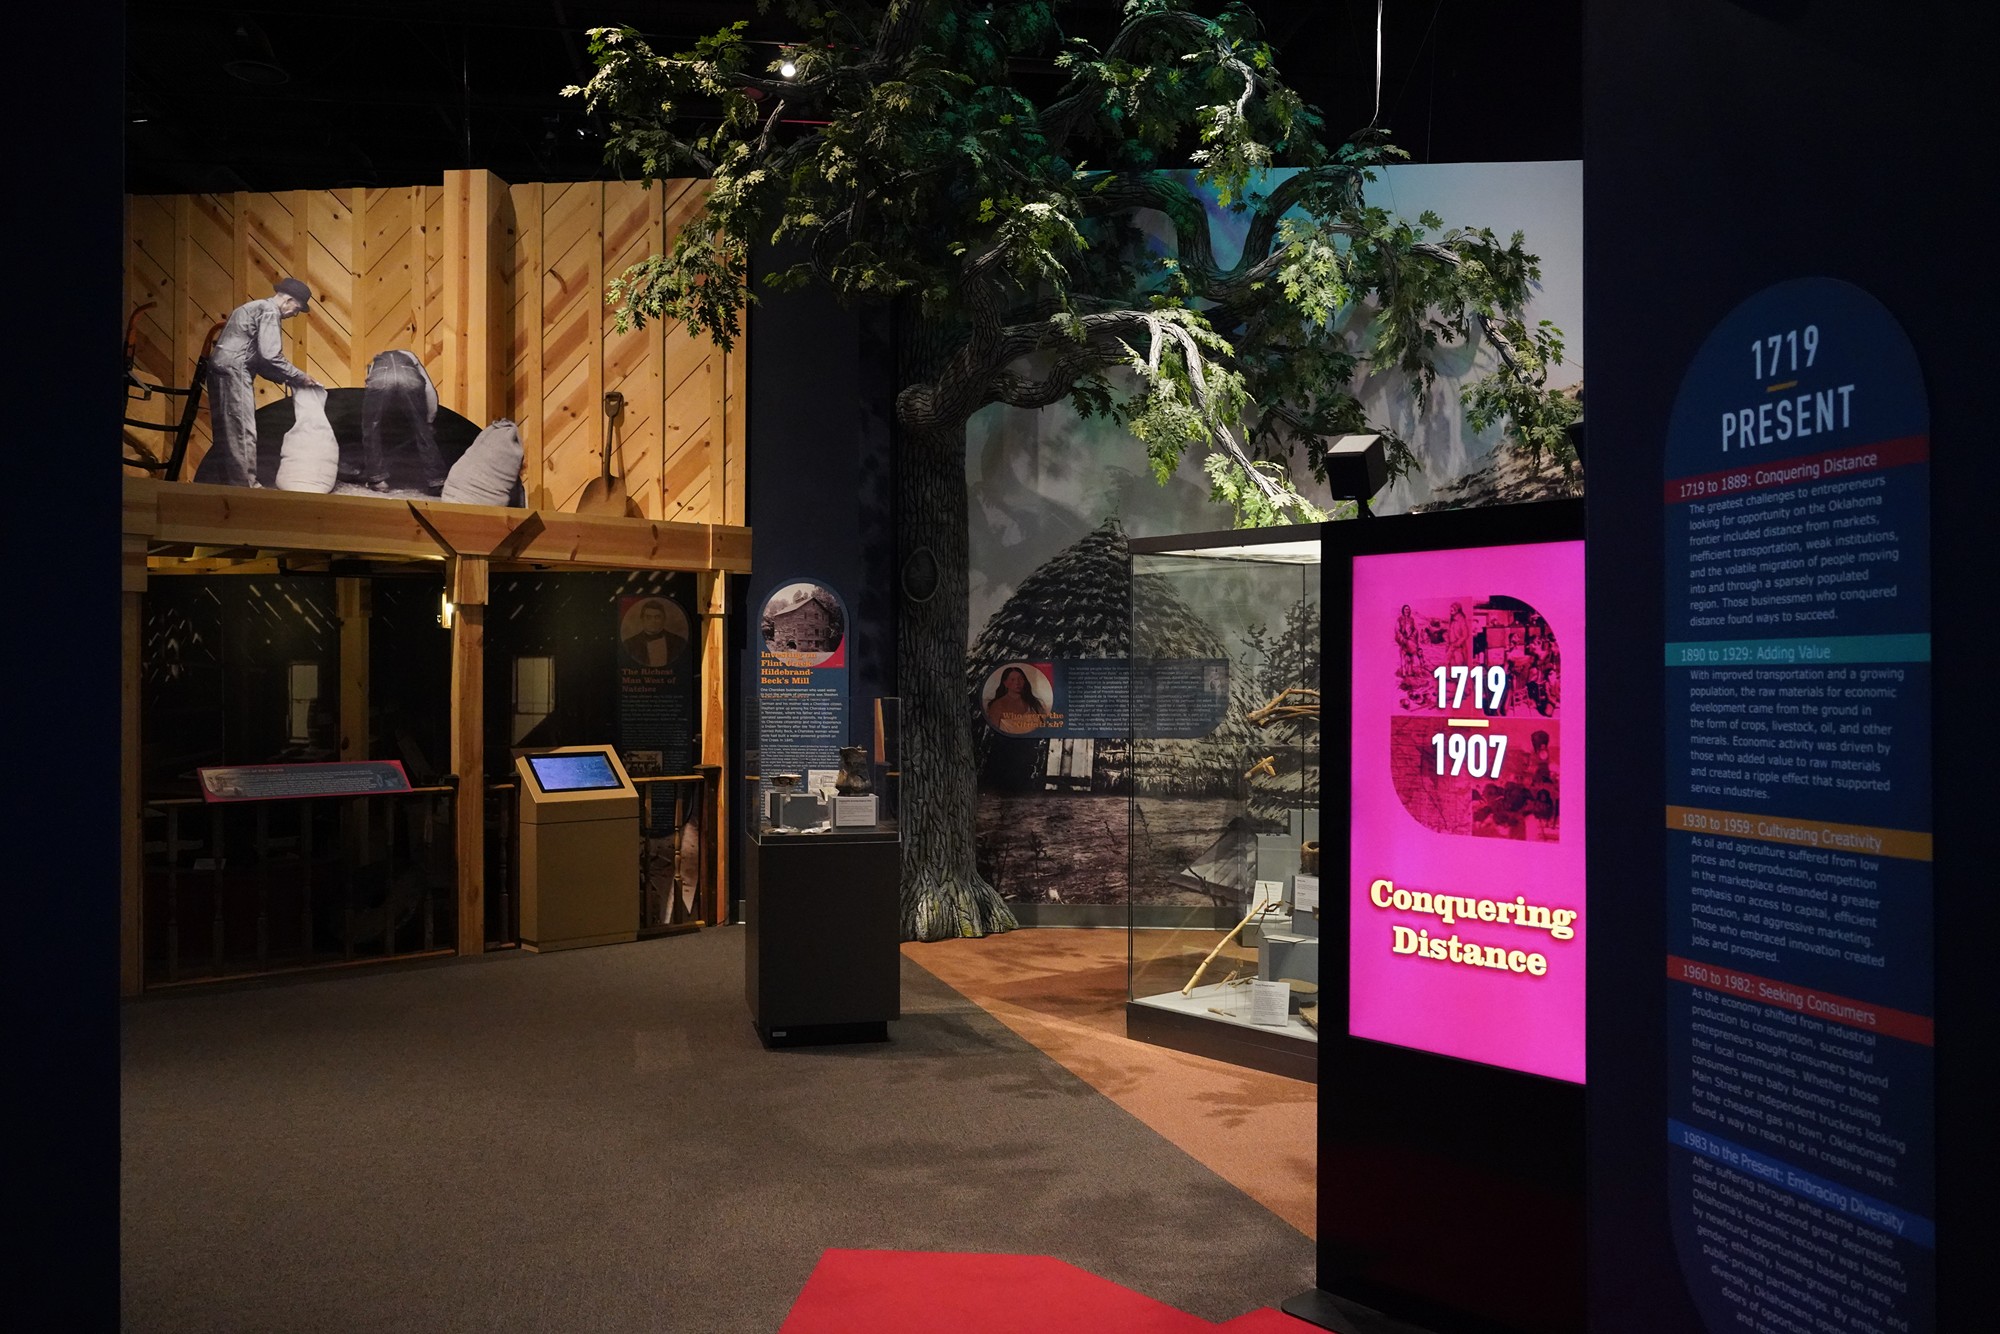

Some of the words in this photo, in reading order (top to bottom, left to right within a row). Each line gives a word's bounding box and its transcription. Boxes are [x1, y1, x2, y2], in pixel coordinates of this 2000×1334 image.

[1751, 324, 1820, 380] 1719
[1722, 384, 1856, 452] PRESENT
[1680, 480, 1705, 498] 1719
[1706, 480, 1718, 493] to
[1721, 473, 1751, 491] 1889:
[1754, 463, 1820, 485] Conquering
[1823, 453, 1877, 474] Distance
[1689, 503, 1705, 514] The
[1706, 497, 1744, 515] greatest
[1745, 490, 1796, 506] challenges
[1797, 487, 1808, 498] to
[1810, 475, 1886, 496] entrepreneurs
[1689, 518, 1720, 531] looking
[1721, 515, 1735, 526] for
[1736, 507, 1791, 525] opportunity
[1793, 506, 1806, 516] on
[1808, 502, 1826, 514] the
[1827, 495, 1882, 511] Oklahoma
[1688, 534, 1721, 546] frontier
[1723, 527, 1761, 542] included
[1762, 524, 1803, 538] distance
[1804, 520, 1830, 532] from
[1832, 514, 1880, 528] markets,
[1689, 548, 1731, 562] inefficient
[1732, 541, 1802, 558] transportation,
[1805, 536, 1832, 549] weak
[1834, 530, 1899, 546] institutions,
[1689, 566, 1706, 578] and
[1707, 566, 1722, 577] the
[1724, 562, 1757, 575] volatile
[1759, 558, 1805, 573] migration
[1807, 555, 1818, 567] of
[1819, 552, 1855, 568] people
[1857, 548, 1899, 562] moving
[1689, 583, 1706, 594] into
[1708, 581, 1725, 593] and
[1726, 578, 1763, 592] through
[1773, 574, 1814, 589] sparsely
[1816, 569, 1869, 586] populated
[1689, 599, 1719, 612] region.
[1721, 597, 1749, 608] Those
[1750, 593, 1813, 606] businessmen
[1815, 590, 1837, 602] who
[1839, 585, 1897, 601] conquered
[1689, 616, 1725, 626] distance
[1727, 612, 1753, 624] found
[1755, 613, 1780, 624] ways
[1781, 611, 1793, 622] to
[1794, 608, 1838, 621] succeed.
[1681, 647, 1706, 662] 1890
[1708, 648, 1719, 661] to
[1722, 646, 1752, 661] 1929:
[1756, 645, 1795, 663] Adding
[1798, 644, 1831, 659] Value
[1433, 665, 1508, 710] 1719
[1690, 670, 1710, 680] With
[1711, 668, 1753, 682] improved
[1755, 668, 1824, 682] transportation
[1826, 668, 1847, 680] and
[1859, 667, 1904, 682] growing
[1689, 685, 1738, 698] population,
[1740, 685, 1756, 697] the
[1758, 688, 1776, 696] raw
[1778, 686, 1824, 697] materials
[1826, 686, 1841, 697] for
[1844, 687, 1896, 698] economic
[1689, 701, 1746, 714] development
[1748, 704, 1774, 714] came
[1775, 703, 1799, 714] from
[1801, 703, 1819, 715] the
[1820, 704, 1858, 718] ground
[1861, 705, 1872, 716] in
[1689, 717, 1704, 728] the
[1706, 718, 1727, 729] form
[1729, 718, 1739, 730] of
[1740, 721, 1768, 732] crops,
[1771, 720, 1817, 734] livestock,
[1820, 721, 1836, 735] oil,
[1839, 722, 1860, 734] and
[1862, 723, 1892, 735] other
[1431, 733, 1508, 779] 1907
[1690, 734, 1729, 746] minerals.
[1732, 735, 1776, 748] Economic
[1777, 738, 1814, 752] activity
[1816, 741, 1837, 751] was
[1839, 740, 1874, 753] driven
[1876, 742, 1891, 756] by
[1690, 749, 1714, 761] those
[1716, 751, 1735, 762] who
[1736, 752, 1765, 764] added
[1767, 754, 1794, 767] value
[1795, 756, 1807, 767] to
[1809, 758, 1828, 768] raw
[1830, 759, 1881, 772] materials
[1690, 766, 1707, 777] and
[1708, 768, 1742, 780] created
[1752, 770, 1780, 784] ripple
[1781, 772, 1809, 785] effect
[1811, 774, 1833, 787] that
[1835, 777, 1891, 792] supported
[1690, 783, 1720, 795] service
[1723, 785, 1770, 799] industries.
[1682, 813, 1707, 829] 1930
[1709, 816, 1720, 831] to
[1724, 817, 1753, 834] 1959:
[1757, 821, 1818, 846] Cultivating
[1821, 829, 1881, 853] Creativity
[1370, 878, 1578, 940] Conquering
[1392, 925, 1548, 977] Distance
[1683, 964, 1708, 982] 1960
[1709, 970, 1721, 985] to
[1724, 974, 1755, 994] 1982:
[1758, 982, 1804, 1010] Seeking
[1806, 994, 1876, 1025] Consumers
[1684, 1131, 1707, 1151] 1983
[1709, 1140, 1720, 1156] to
[1721, 1145, 1738, 1164] the
[1740, 1152, 1784, 1182] Present:
[1787, 1170, 1847, 1211] Embracing
[1850, 1196, 1903, 1234] Diversity
